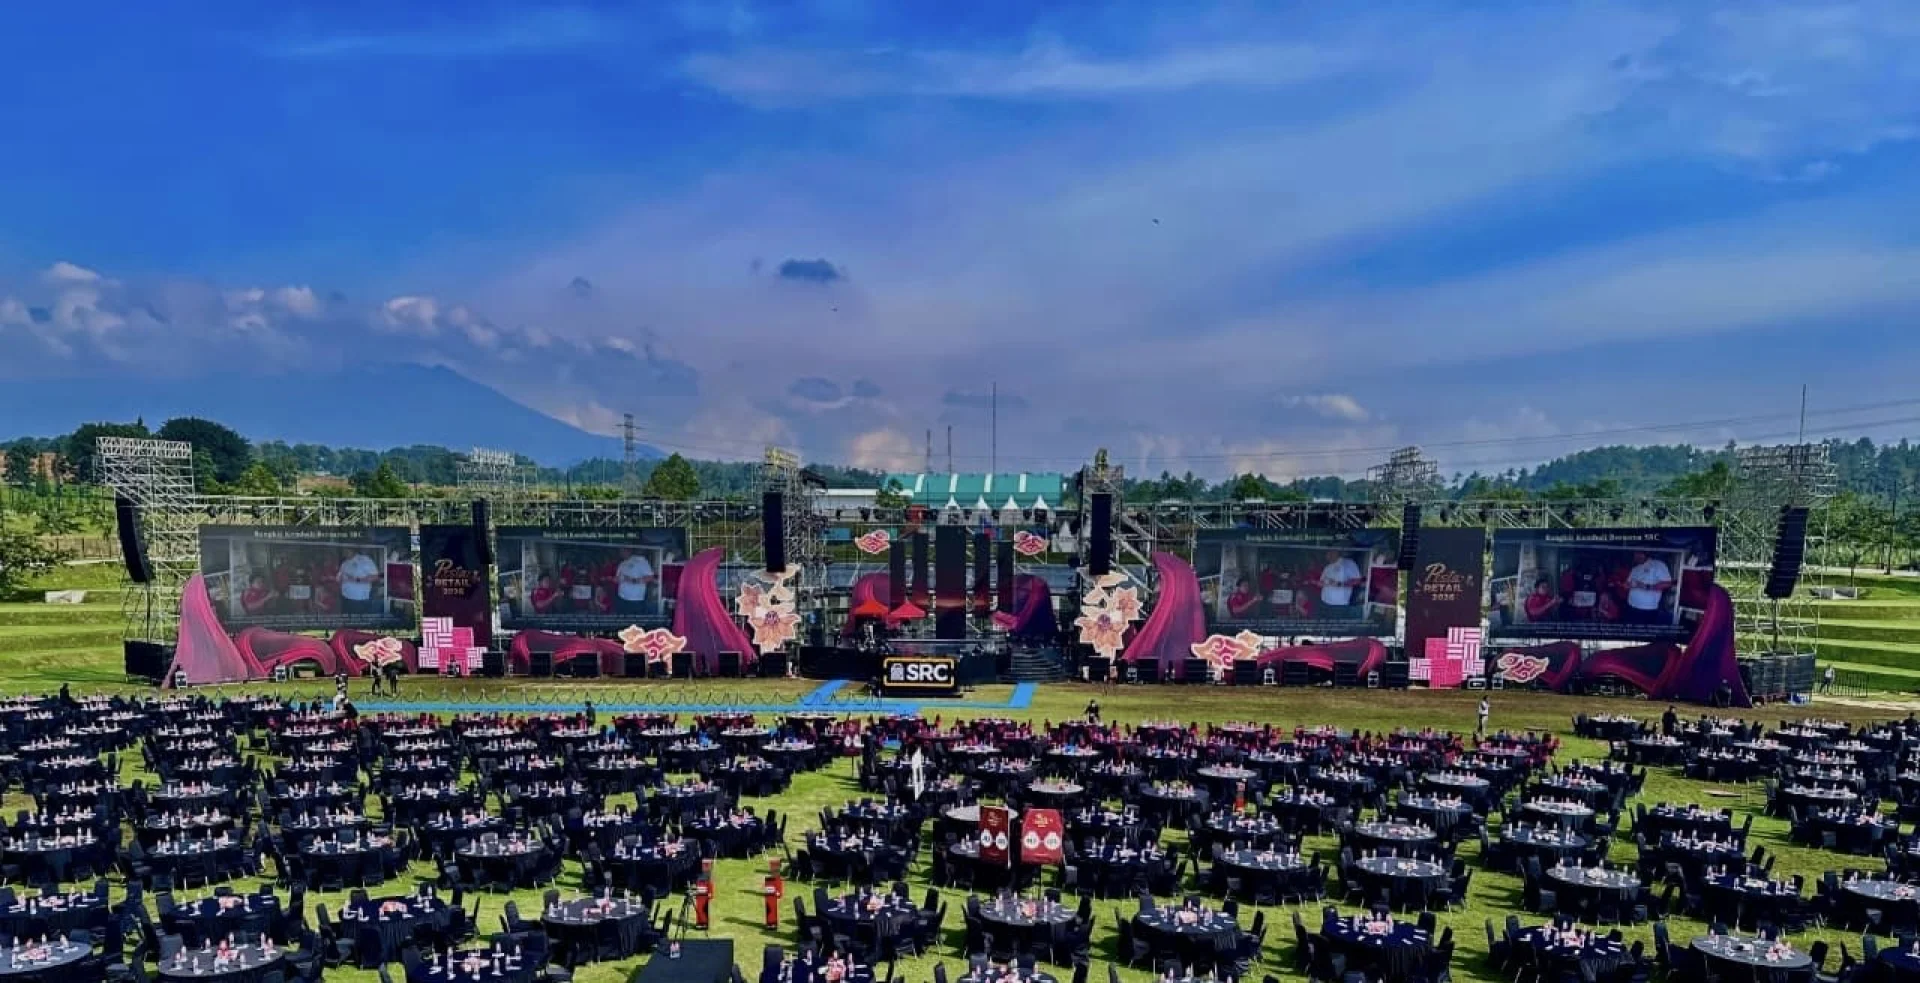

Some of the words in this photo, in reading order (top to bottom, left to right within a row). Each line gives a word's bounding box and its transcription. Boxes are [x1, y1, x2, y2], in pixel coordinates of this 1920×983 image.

[434, 578, 471, 587] RETAIL
[1424, 583, 1464, 593] RETAIL
[906, 663, 949, 681] SRC
